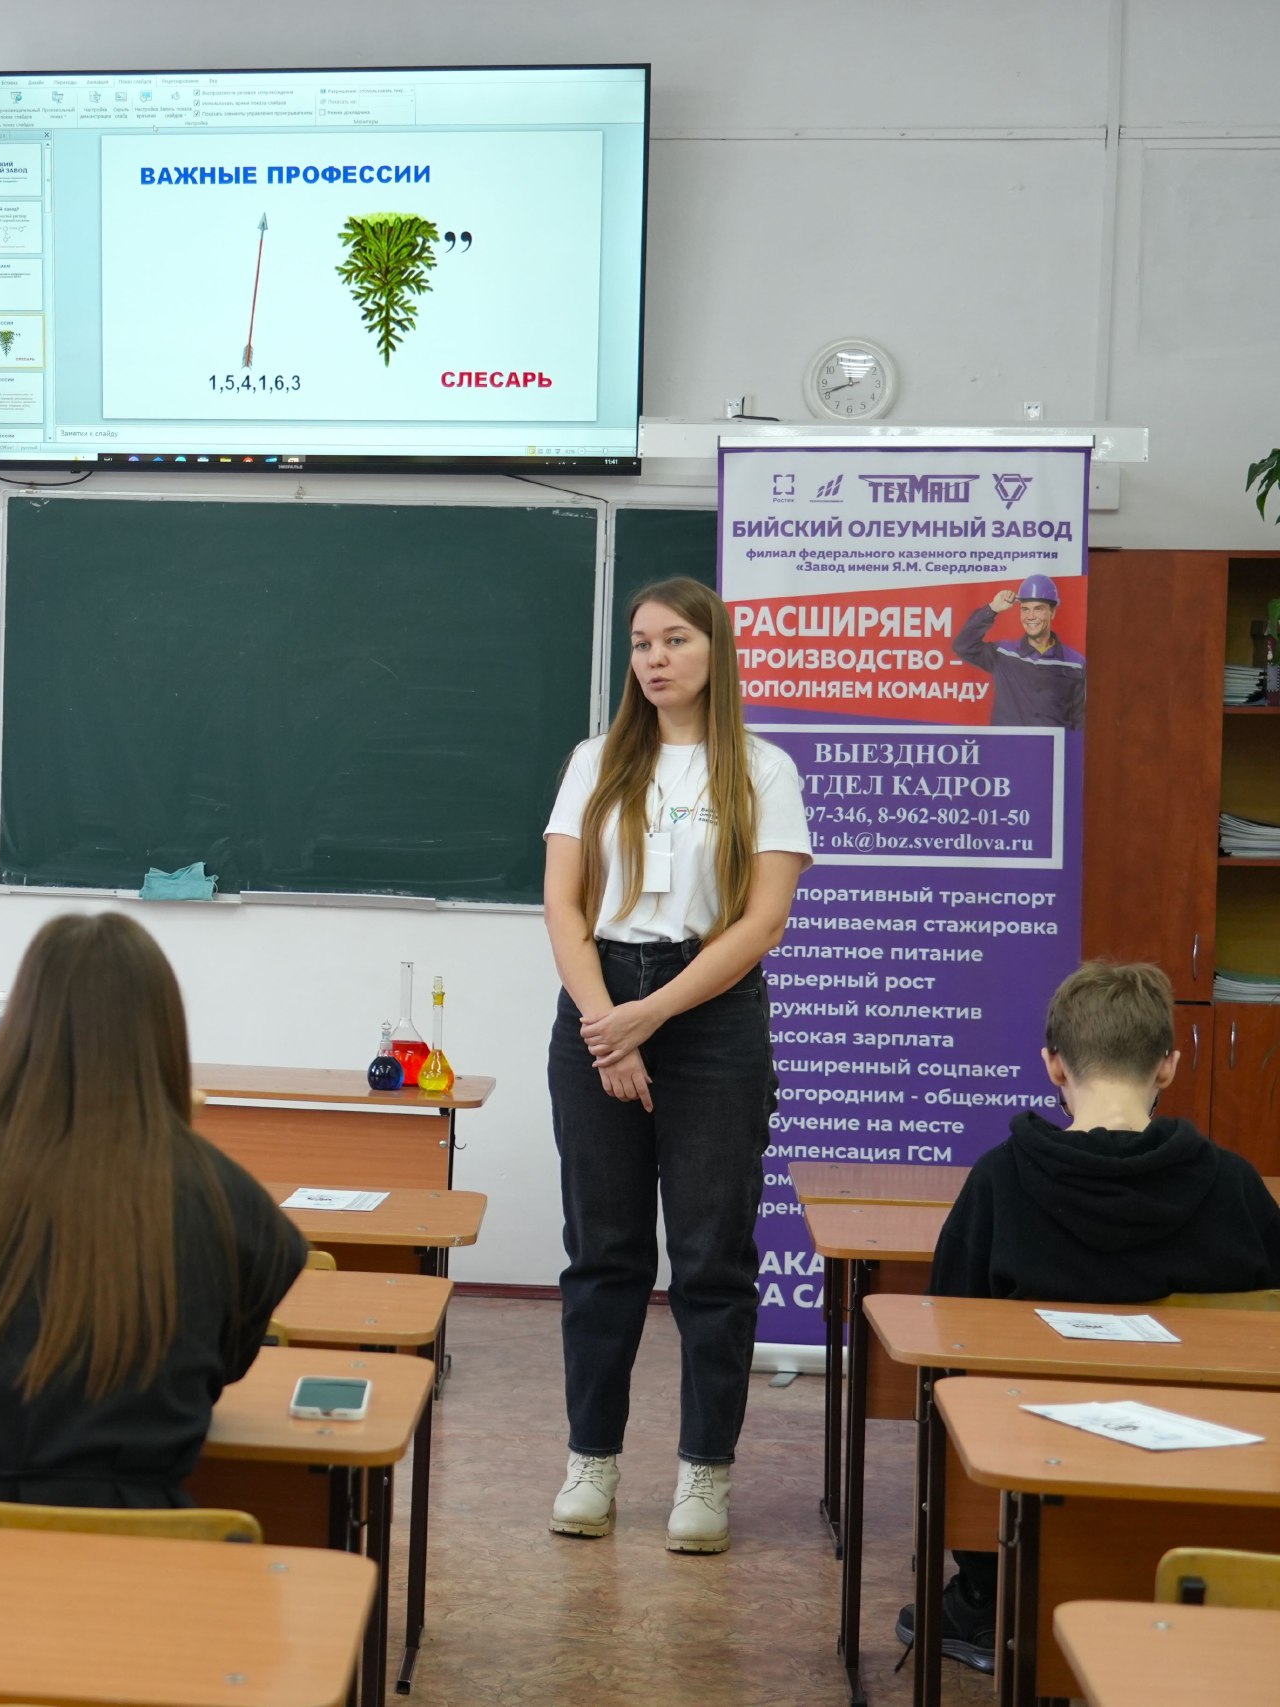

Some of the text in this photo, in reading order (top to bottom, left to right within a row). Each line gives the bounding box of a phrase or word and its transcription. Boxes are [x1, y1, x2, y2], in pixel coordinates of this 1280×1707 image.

[140, 165, 431, 185] ВАЖНЫЕ ПРОФЕССИИ
[825, 366, 835, 374] 10
[871, 367, 877, 376] 2
[209, 375, 301, 393] 1,5,4,1,6,3
[441, 371, 552, 388] СЛЕСАРЬ
[821, 378, 828, 388] 9
[874, 379, 881, 388] 3
[824, 391, 831, 400] 8
[869, 392, 875, 401] 4
[834, 401, 840, 409] 7
[846, 405, 853, 414] 6
[859, 402, 866, 410] 5
[60, 429, 88, 437] Заметки
[95, 429, 119, 438] слайду
[732, 516, 1072, 542] БИЙСКИЙ ОЛЕУМНЫЙ ЗАВОД
[746, 548, 1058, 561] филиал федерального казенного предприятия
[796, 561, 1007, 574] «Завод имени Я.М. Свердлова»
[734, 606, 953, 638] РАСШИРЯЕМ
[736, 648, 944, 673] ПРОИЗВОДСТВО
[878, 681, 989, 702] КОМАНДУ
[814, 739, 980, 767] ВЫЕЗДНОЙ
[891, 775, 1011, 799] КАДРОВ
[877, 807, 1030, 827] 8-962-802-01-50
[831, 831, 1033, 852] ok@boz.sverdlova.ru
[792, 886, 1056, 909] поративный транспорт
[923, 919, 1058, 937] стажировка
[890, 949, 984, 963] питание
[762, 970, 936, 992] арьерный рост
[865, 1004, 982, 1020] коллектив
[853, 1032, 954, 1049] зарплата
[917, 1062, 1021, 1079] соцпакет
[924, 1089, 1057, 1108] общежитие
[866, 1119, 893, 1132] на
[899, 1120, 964, 1134] месте
[761, 1143, 952, 1163] омпенсация ГСМ
